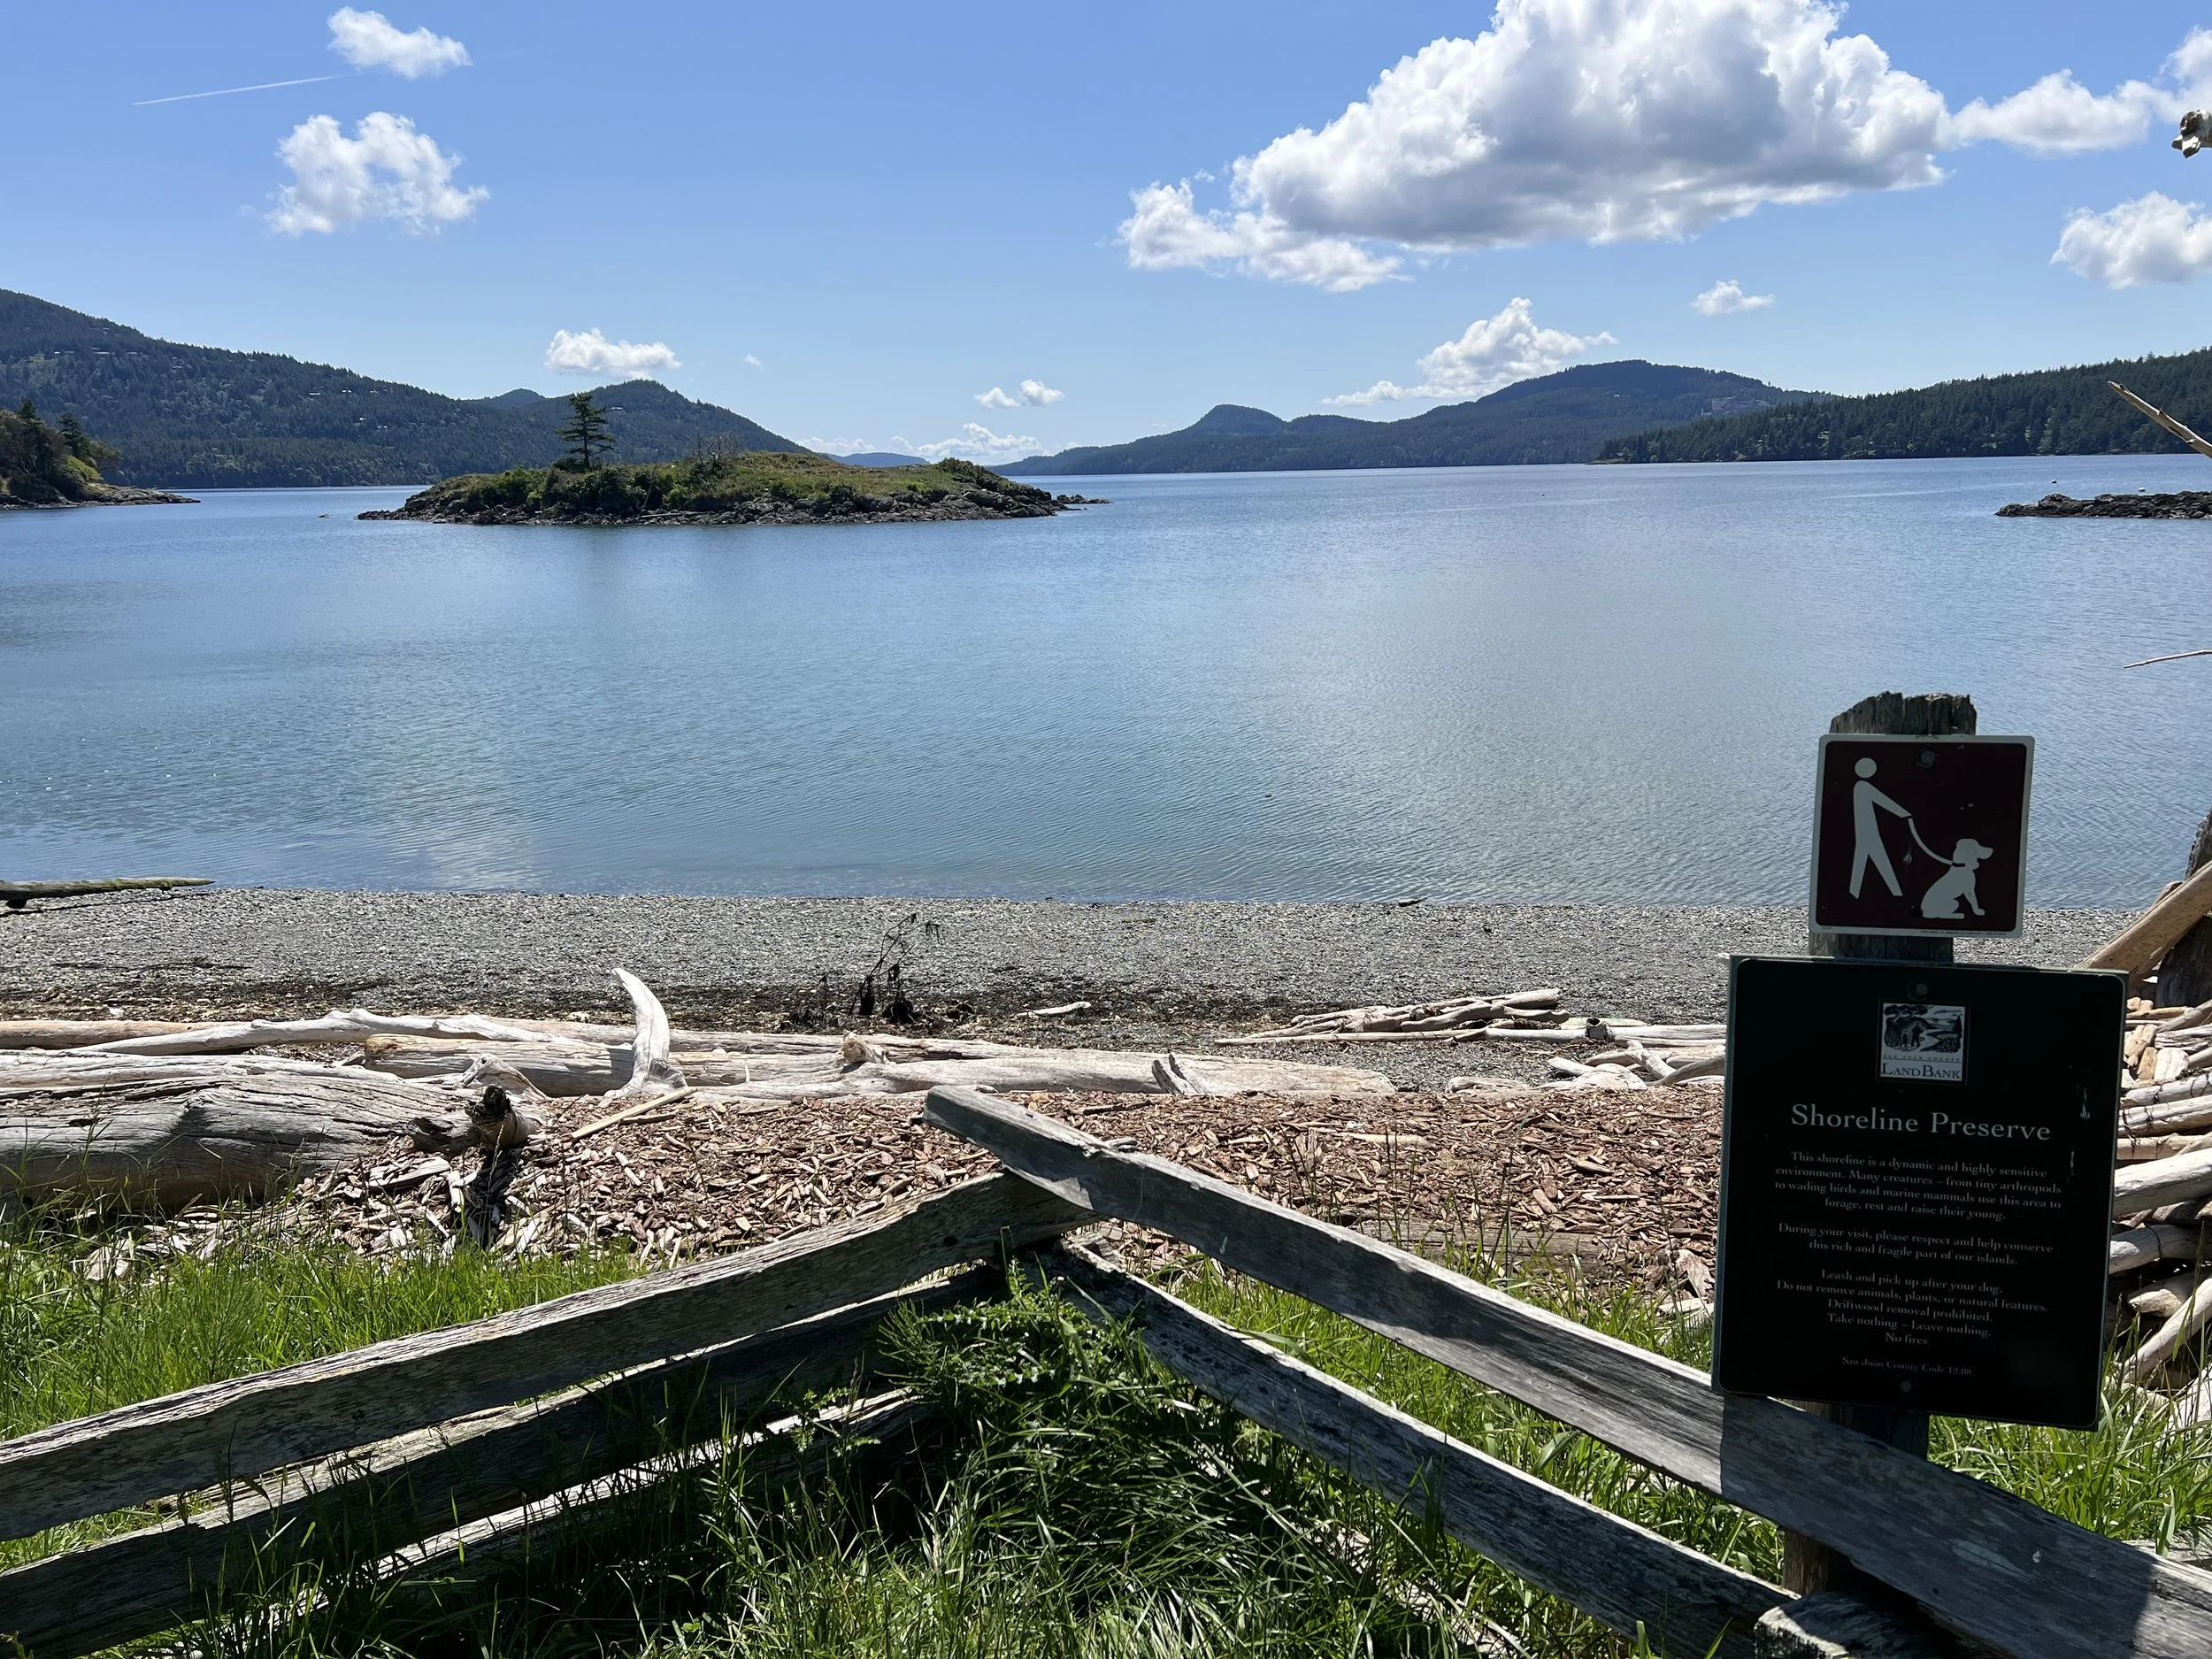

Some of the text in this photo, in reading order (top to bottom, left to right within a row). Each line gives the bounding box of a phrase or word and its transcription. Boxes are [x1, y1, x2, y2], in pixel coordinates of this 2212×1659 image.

[1791, 1103, 2052, 1141] Shoreline Preserve
[1791, 1150, 1814, 1162] This
[1817, 1153, 1865, 1165] shoreline
[1868, 1156, 1877, 1166] is
[1888, 1157, 1935, 1170] dynamic
[1938, 1162, 1958, 1172] and
[1962, 1162, 1996, 1176] highly
[1999, 1166, 2047, 1178] sensitive
[1775, 1166, 1846, 1179] environment.
[1848, 1170, 1880, 1183] Many
[1883, 1175, 1933, 1185] creatures
[1946, 1177, 1972, 1187] from
[1976, 1179, 1997, 1191] tiny
[2000, 1181, 2062, 1194] arthropods
[1788, 1181, 1826, 1194] wading
[1830, 1183, 1856, 1194] birds
[1859, 1186, 1879, 1195] and
[1883, 1188, 1921, 1199] marine
[1924, 1192, 1975, 1203] mammals
[2000, 1194, 2019, 1206] this
[1887, 1202, 1908, 1213] and
[1911, 1204, 1936, 1215] raise
[1939, 1205, 1966, 1217] their
[1778, 1222, 1816, 1236] During
[1817, 1228, 1845, 1238] your
[1875, 1230, 1909, 1242] please
[1912, 1235, 1950, 1247] respect
[1954, 1237, 1974, 1247] and
[1977, 1237, 2001, 1251] help
[2004, 1242, 2053, 1253] conserve
[1809, 1239, 1829, 1249] this
[1832, 1240, 1852, 1252] rich
[1855, 1244, 1875, 1254] and
[1878, 1244, 1913, 1258] fragile
[1916, 1249, 1938, 1260] part
[1940, 1250, 1952, 1260] of
[1977, 1252, 2018, 1265] islands.
[1821, 1268, 1853, 1281] Leash
[1855, 1272, 1876, 1283] and
[1878, 1274, 1901, 1286] pick
[1905, 1279, 1919, 1289] up
[1922, 1278, 1947, 1288] after
[1948, 1282, 1977, 1293] your
[1777, 1279, 1793, 1290] Do
[1816, 1286, 1855, 1295] remove
[1959, 1297, 1998, 1308] natural
[2001, 1298, 2048, 1312] features.
[1828, 1298, 1883, 1312] Driftwood
[1886, 1306, 1930, 1317] removal
[1827, 1312, 1855, 1325] Take
[1857, 1317, 1898, 1330] nothing
[1911, 1320, 1944, 1332] Leave
[1947, 1325, 1993, 1339] nothing.
[1885, 1333, 1901, 1343] No
